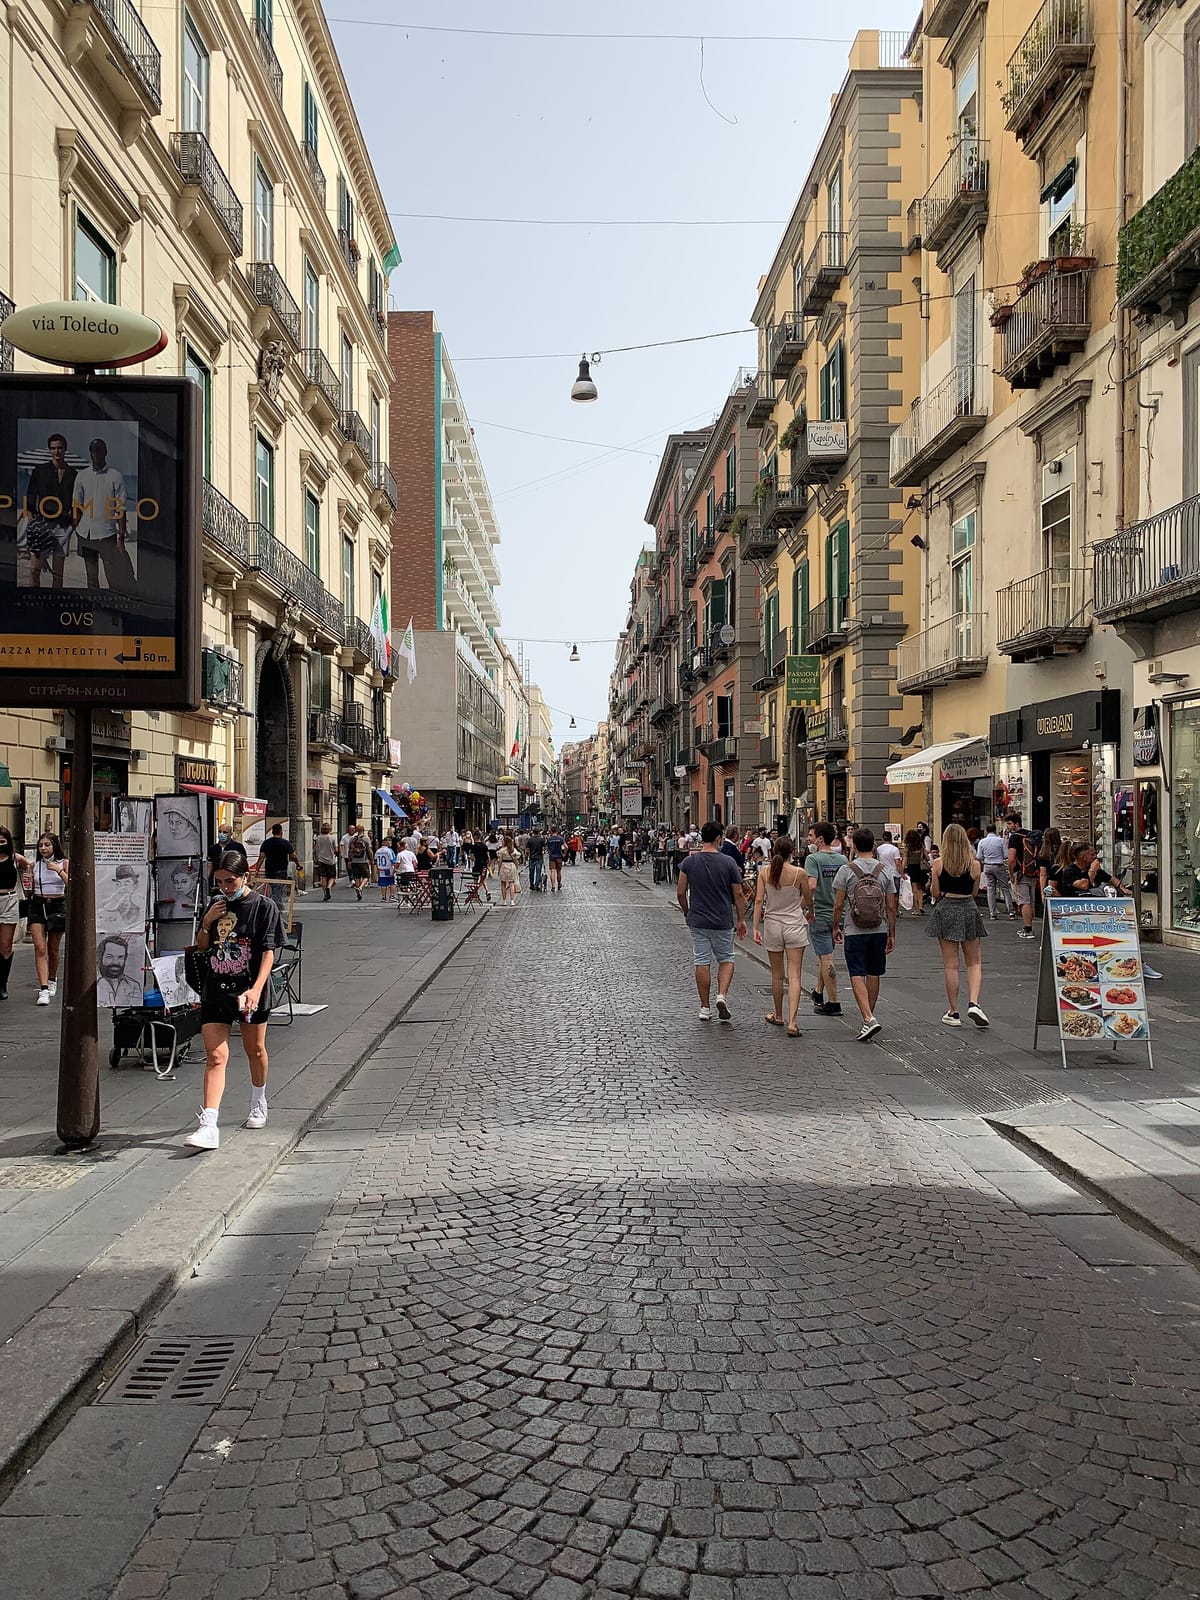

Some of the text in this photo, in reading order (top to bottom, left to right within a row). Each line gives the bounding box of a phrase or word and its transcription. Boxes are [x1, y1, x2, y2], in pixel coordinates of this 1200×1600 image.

[32, 315, 119, 335] via Toledo
[60, 611, 94, 626] OVS
[38, 647, 107, 657] MATTEOTTI
[143, 653, 170, 663] 50 m.
[84, 687, 126, 697] NAPOLI
[1037, 713, 1073, 735] URBAN
[377, 855, 387, 867] 10
[1057, 902, 1127, 919] Trattoria
[1060, 917, 1129, 934] Toledo
